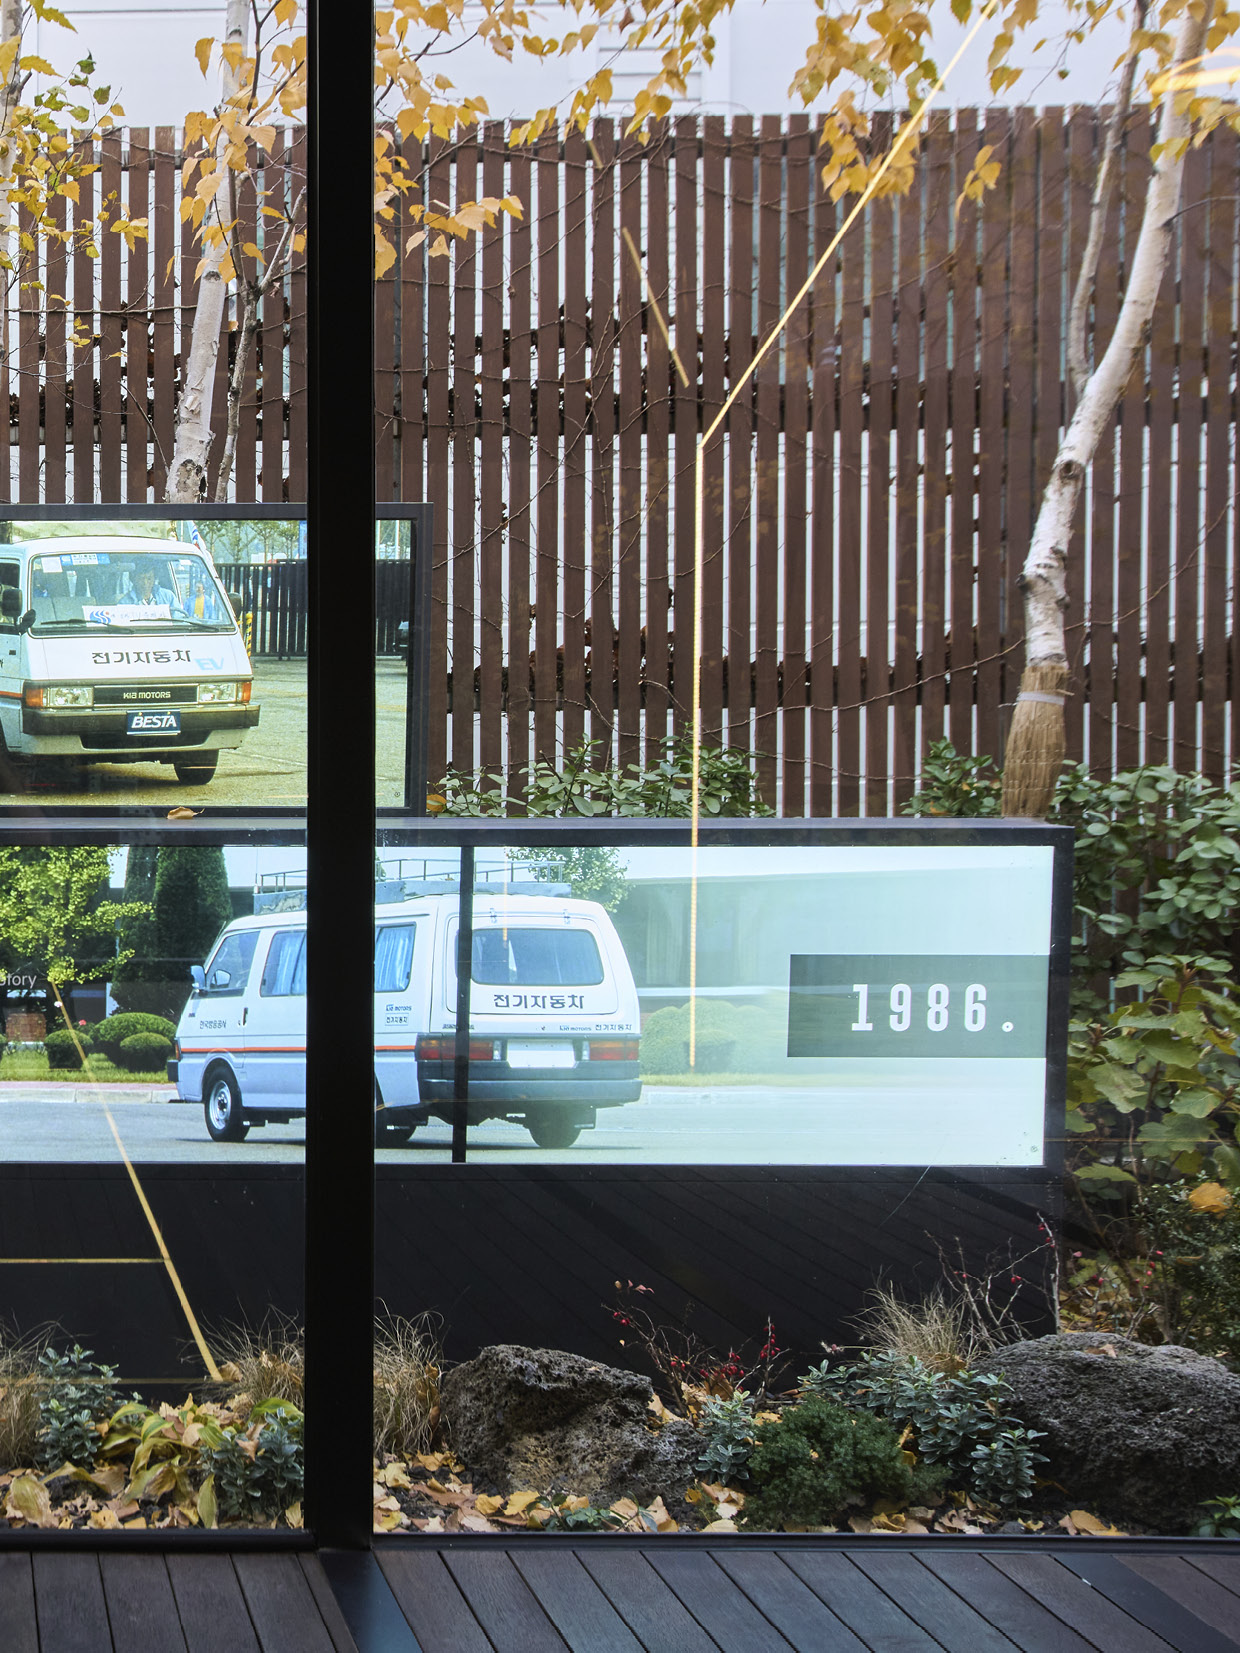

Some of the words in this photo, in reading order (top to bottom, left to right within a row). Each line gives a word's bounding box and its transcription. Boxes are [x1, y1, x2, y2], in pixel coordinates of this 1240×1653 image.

[92, 649, 191, 664] 전기자동차
[194, 657, 224, 671] EV
[138, 691, 171, 699] MOTORS
[131, 715, 178, 729] BESTA
[493, 993, 585, 1010] 전기자동차
[851, 983, 1014, 1032] 1986.
